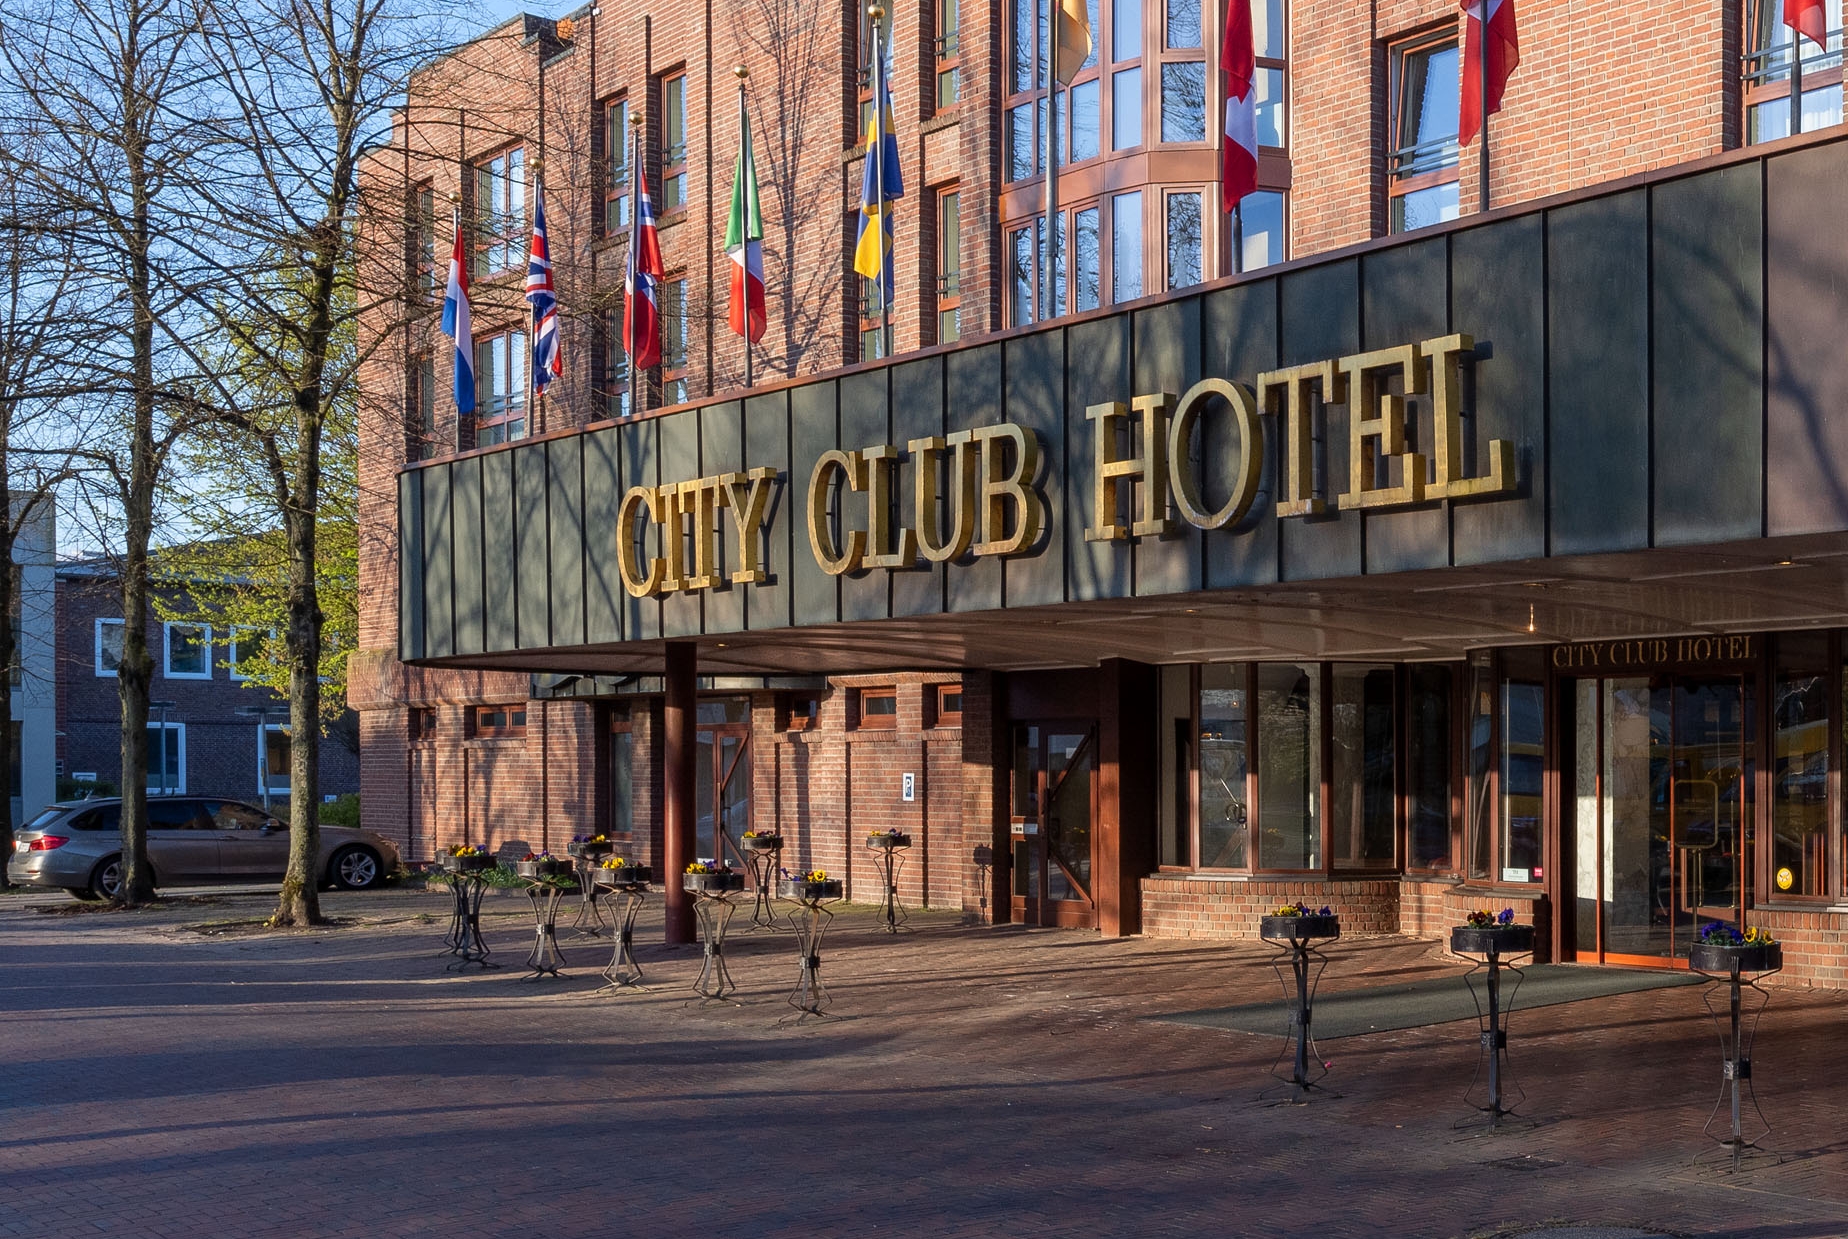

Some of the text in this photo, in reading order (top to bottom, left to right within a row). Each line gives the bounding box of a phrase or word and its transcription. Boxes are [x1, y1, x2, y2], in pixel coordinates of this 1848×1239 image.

[617, 333, 1516, 598] CITY CLUB HOTEL
[1553, 635, 1757, 668] CITY CLUB HOTEL
